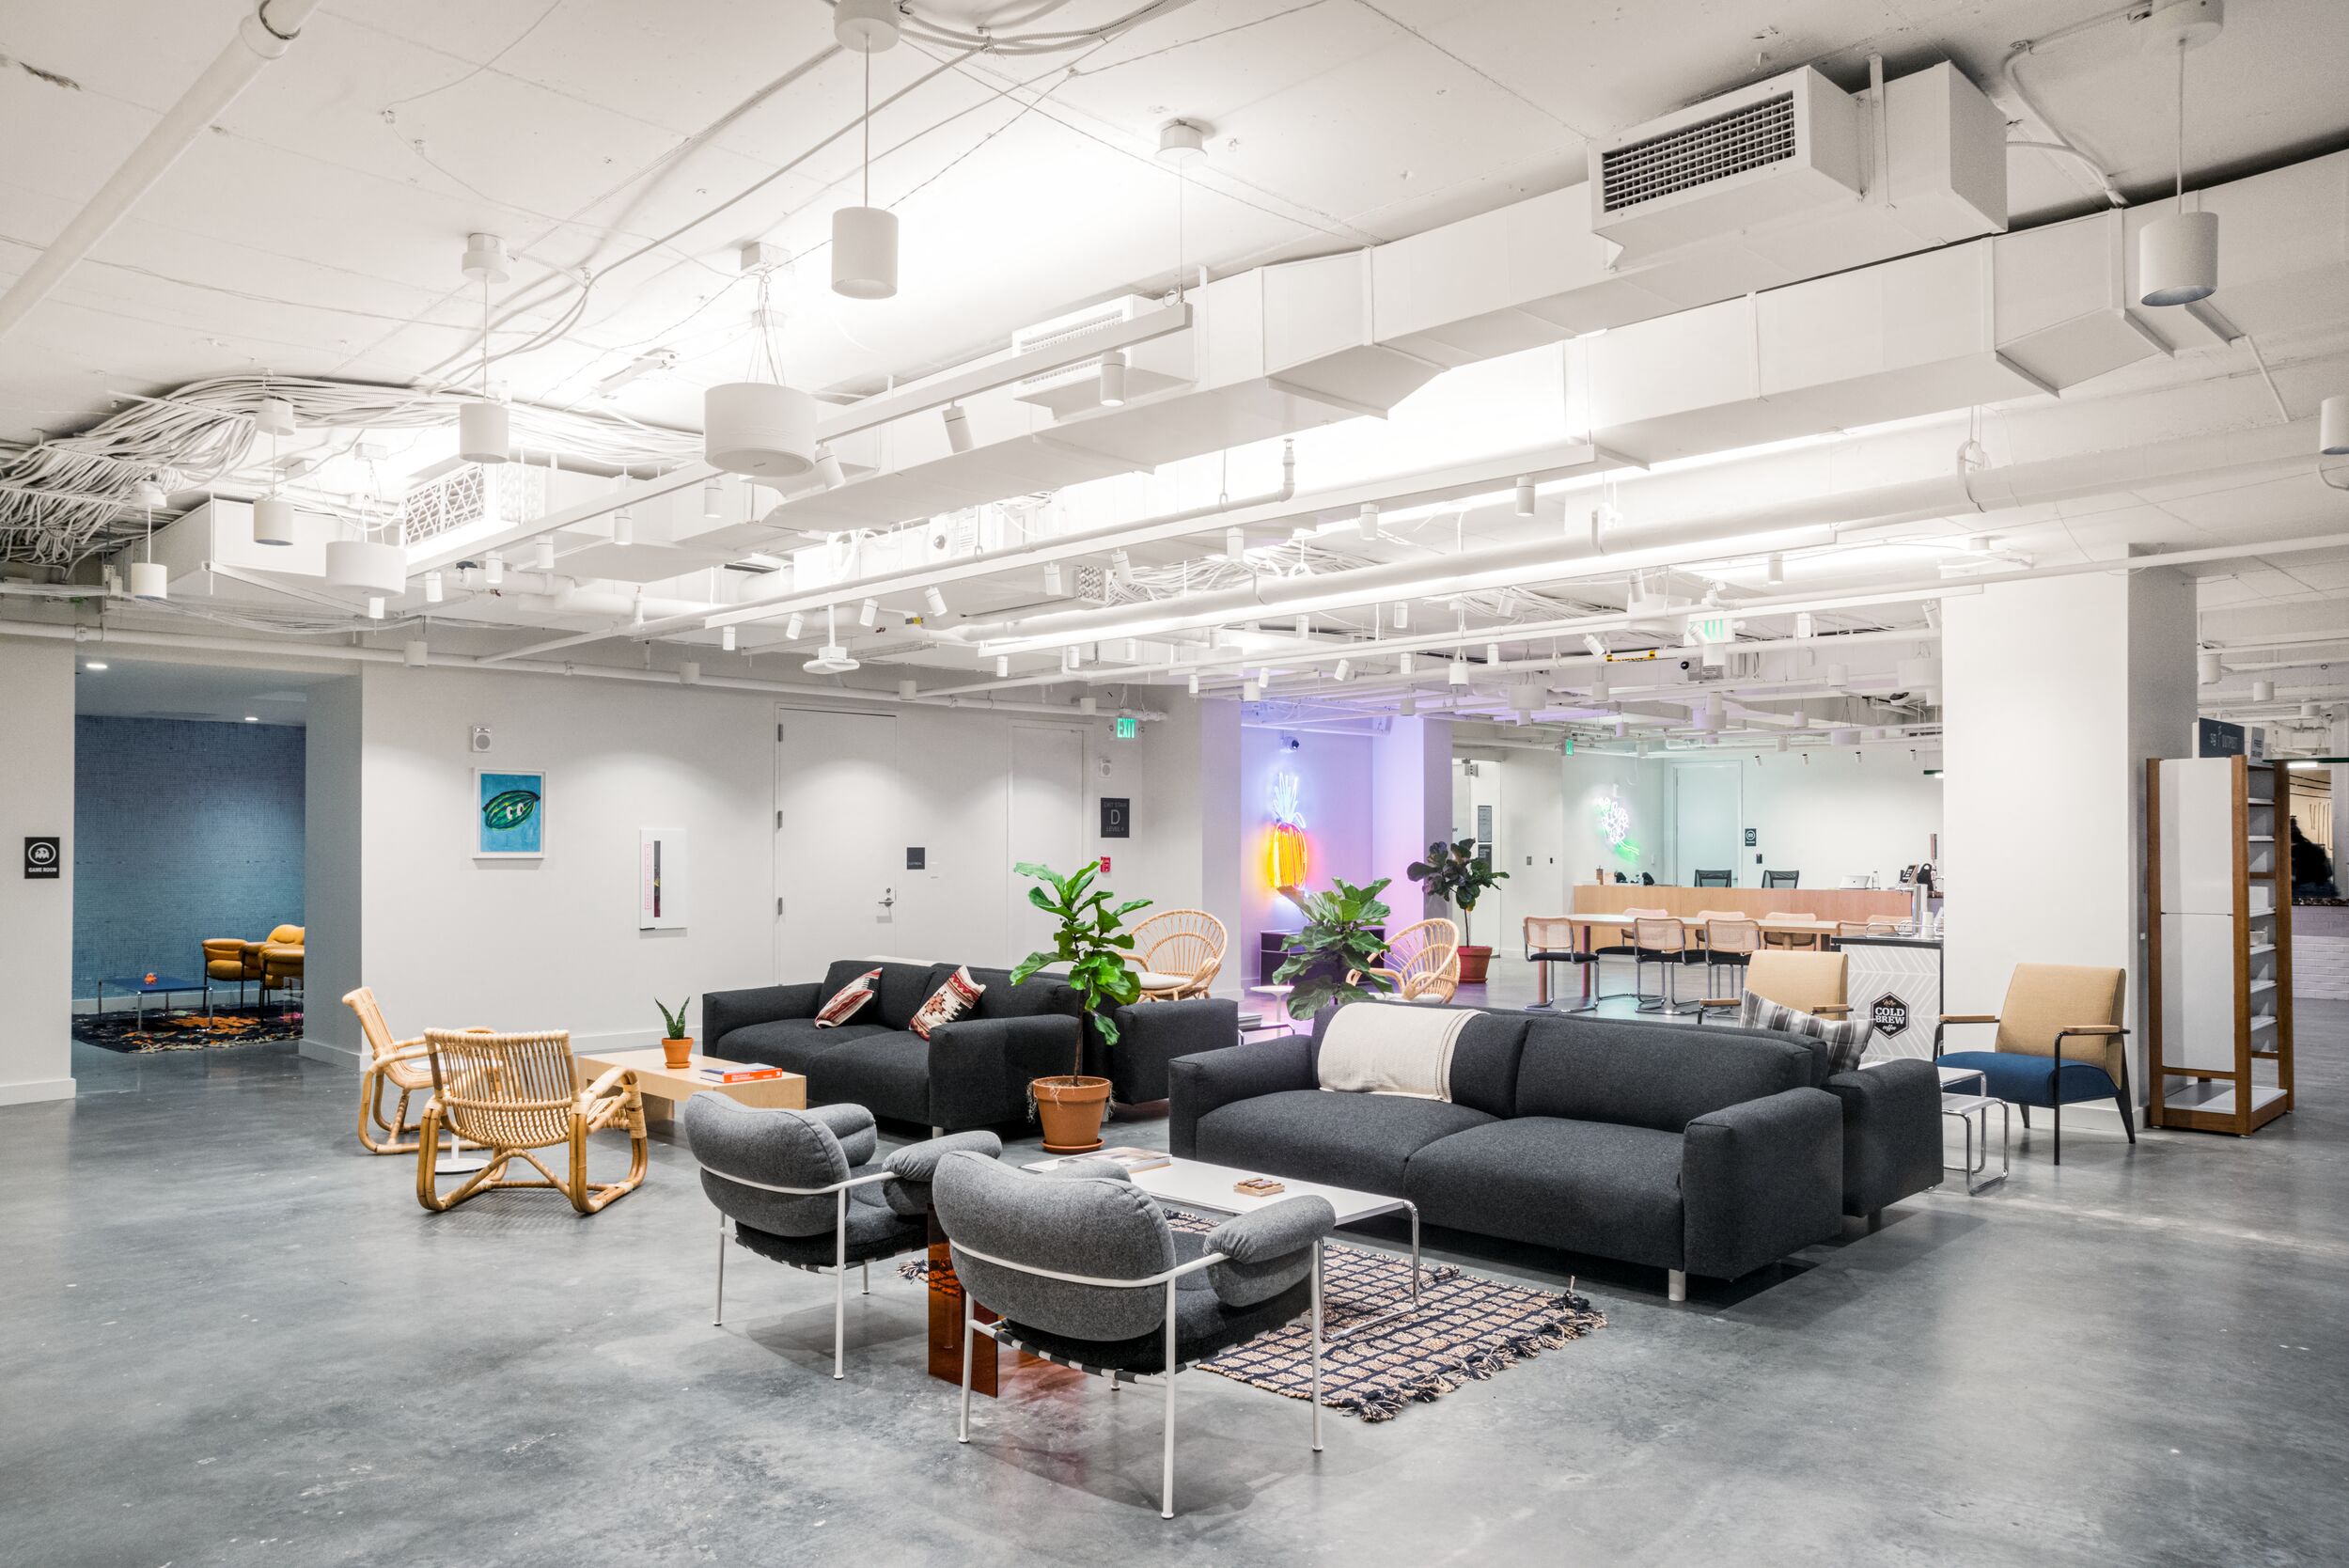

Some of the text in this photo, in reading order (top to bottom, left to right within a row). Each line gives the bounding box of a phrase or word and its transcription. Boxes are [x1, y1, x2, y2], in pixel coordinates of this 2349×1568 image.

[1117, 717, 1136, 738] EXIT
[1110, 809, 1120, 825] D
[1874, 1007, 1905, 1017] COLD
[1875, 1015, 1905, 1025] BREW
